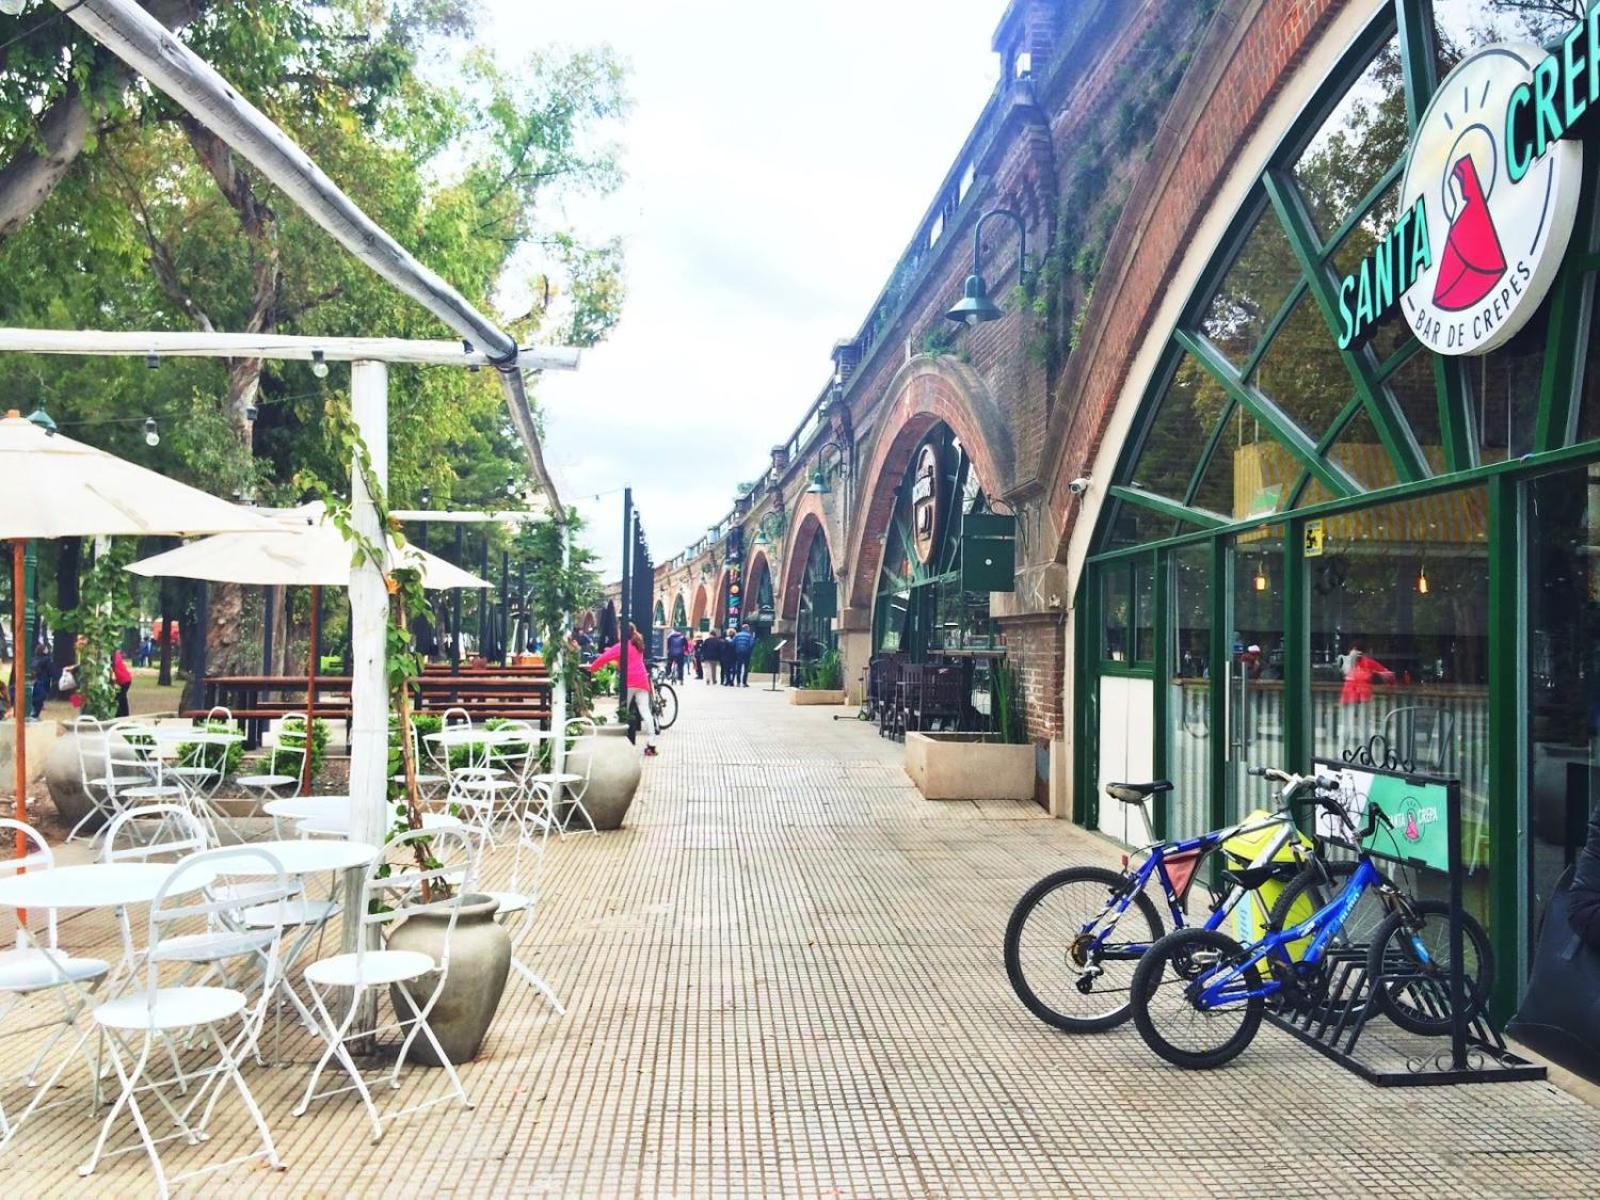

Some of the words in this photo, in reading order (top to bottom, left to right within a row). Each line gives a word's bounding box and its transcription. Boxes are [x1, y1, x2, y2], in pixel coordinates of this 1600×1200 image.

[1338, 196, 1432, 349] SANTA
[1415, 308, 1441, 345] BAR
[1447, 323, 1465, 348] DE
[1473, 261, 1531, 340] CREPES
